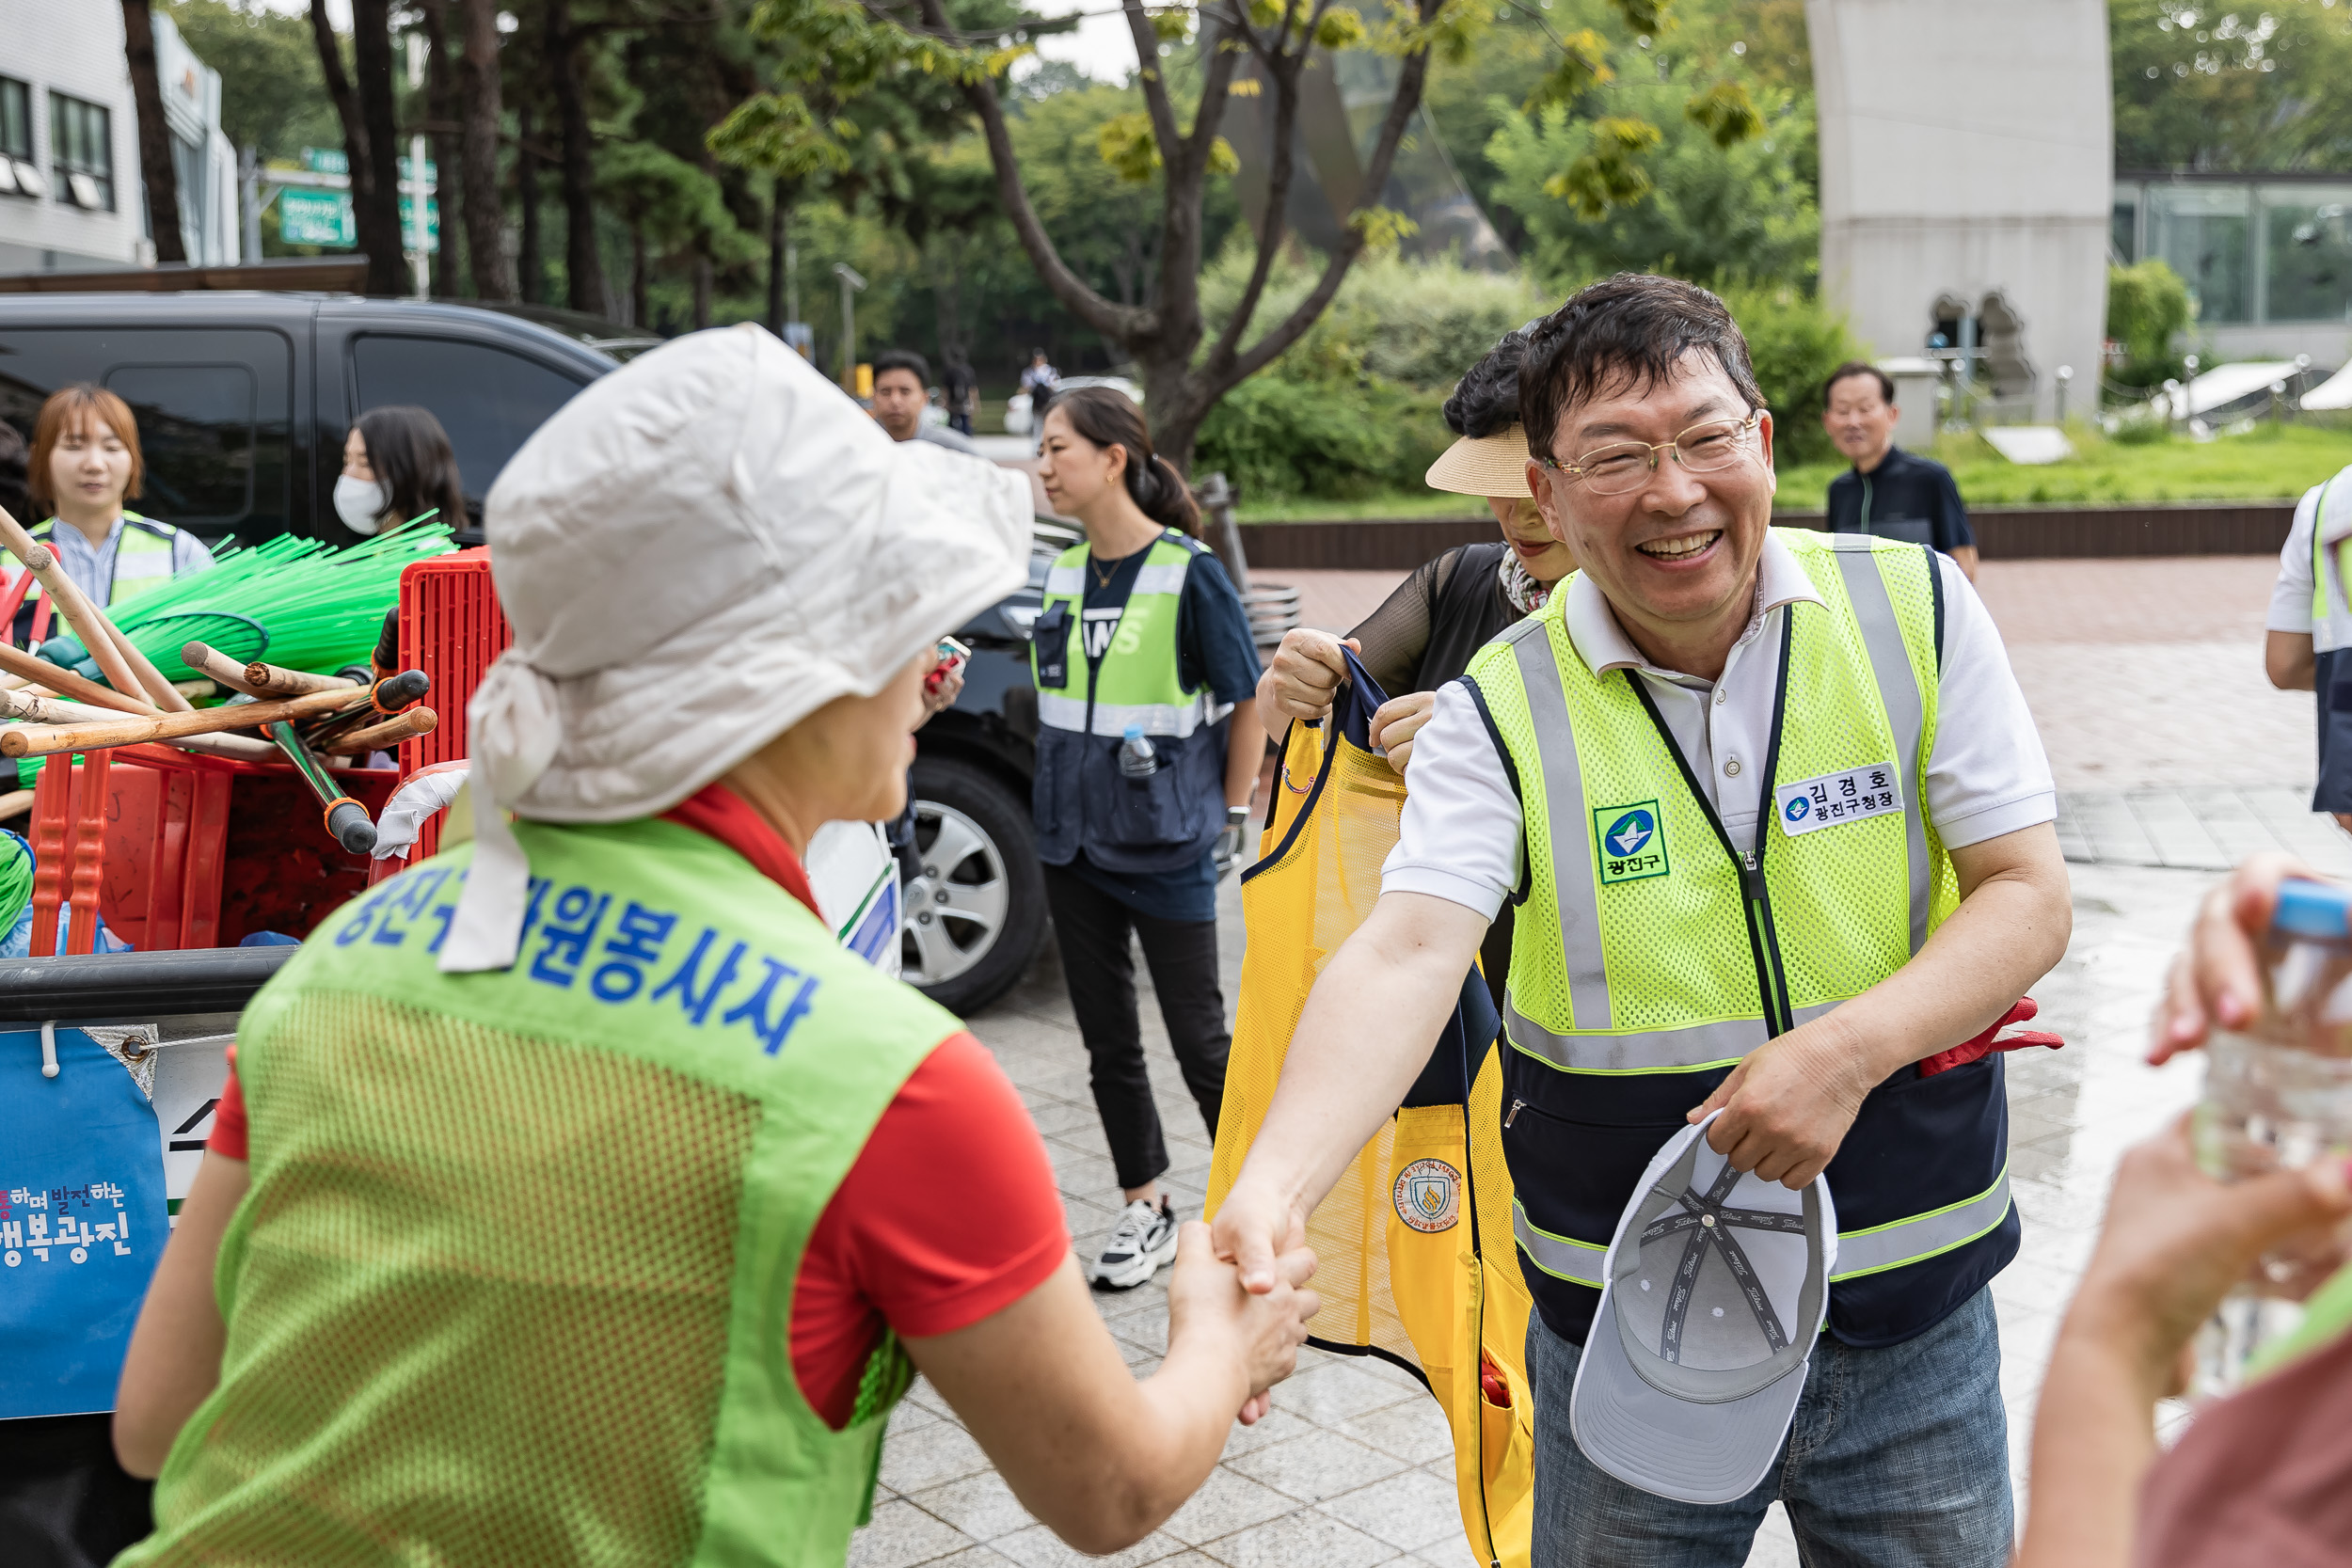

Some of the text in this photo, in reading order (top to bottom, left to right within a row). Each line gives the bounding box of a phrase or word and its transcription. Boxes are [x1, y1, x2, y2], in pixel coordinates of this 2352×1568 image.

[1815, 791, 1893, 821] 광진구청장
[1607, 854, 1661, 876] 광진구
[51, 1180, 125, 1215] 발전하는
